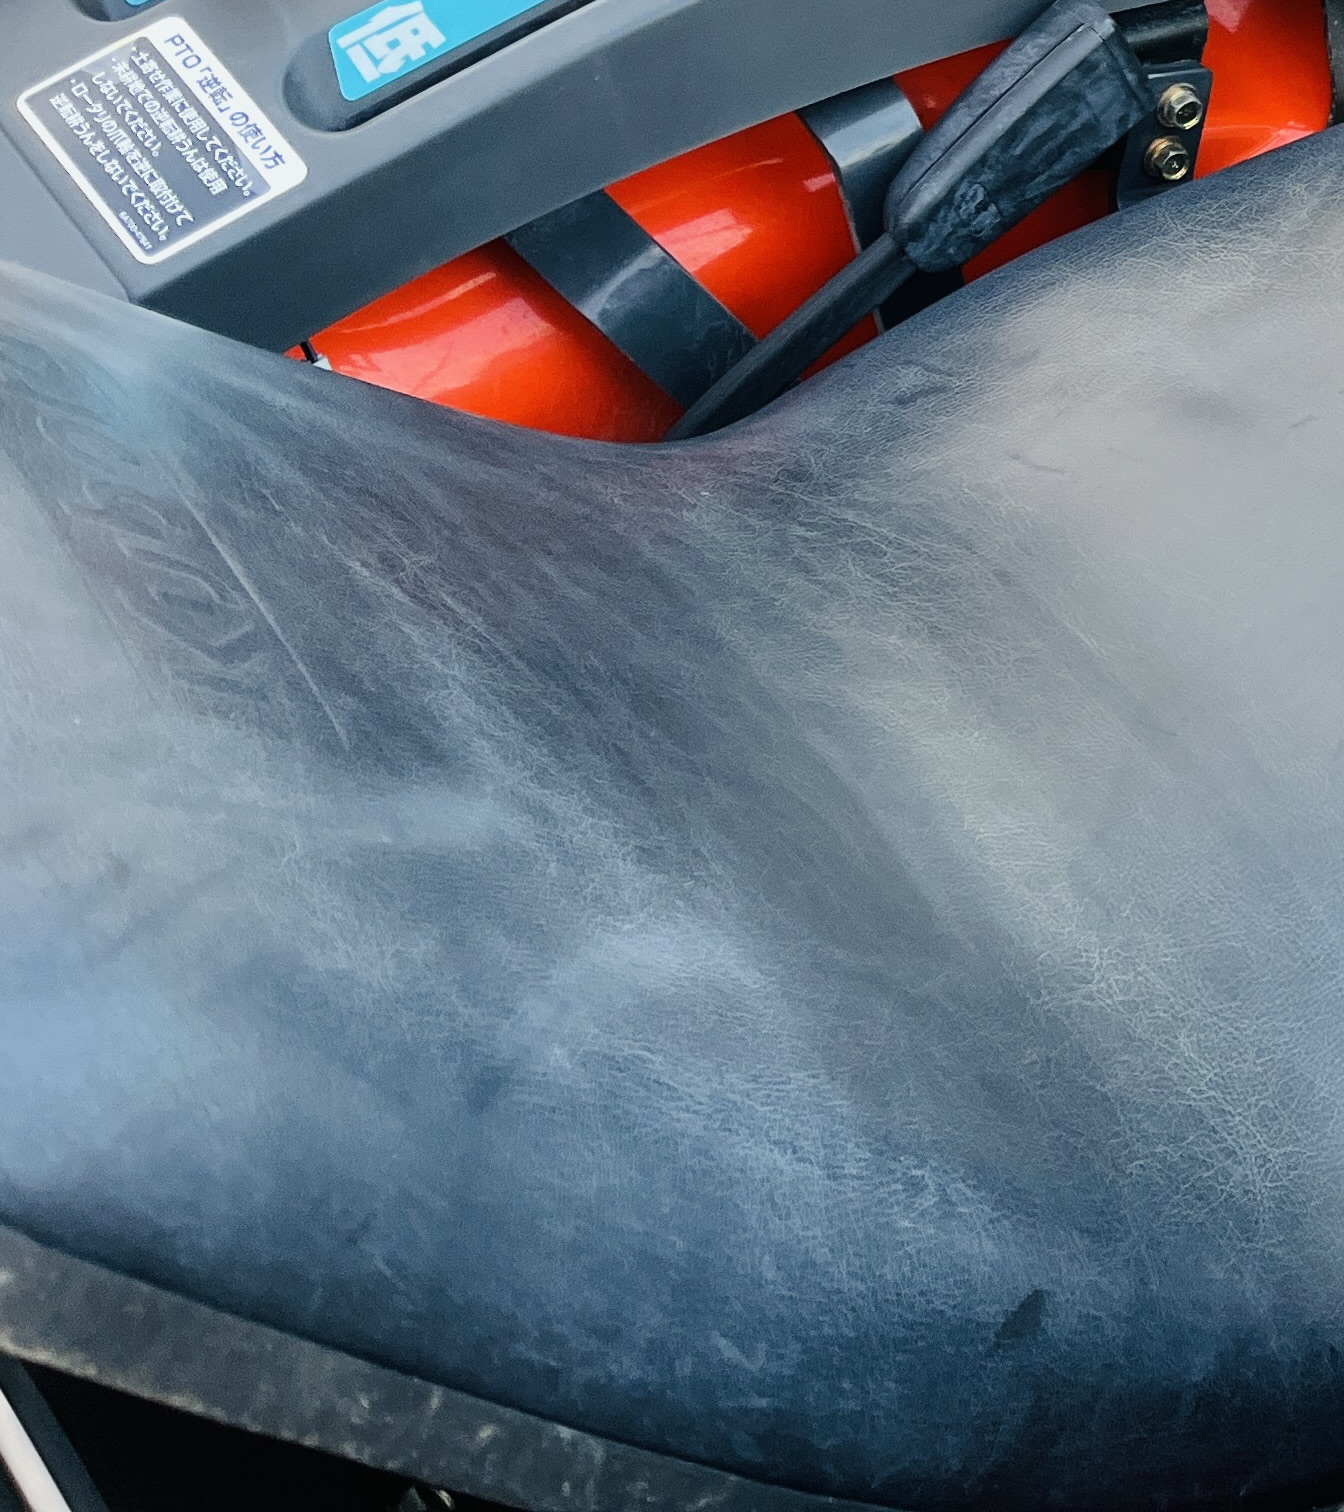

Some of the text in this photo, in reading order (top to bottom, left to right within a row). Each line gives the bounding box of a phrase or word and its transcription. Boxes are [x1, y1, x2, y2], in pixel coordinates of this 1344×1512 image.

[336, 0, 447, 83] 低
[89, 69, 165, 159] しないでください。
[162, 29, 288, 174] PTO「逆転」の使い方
